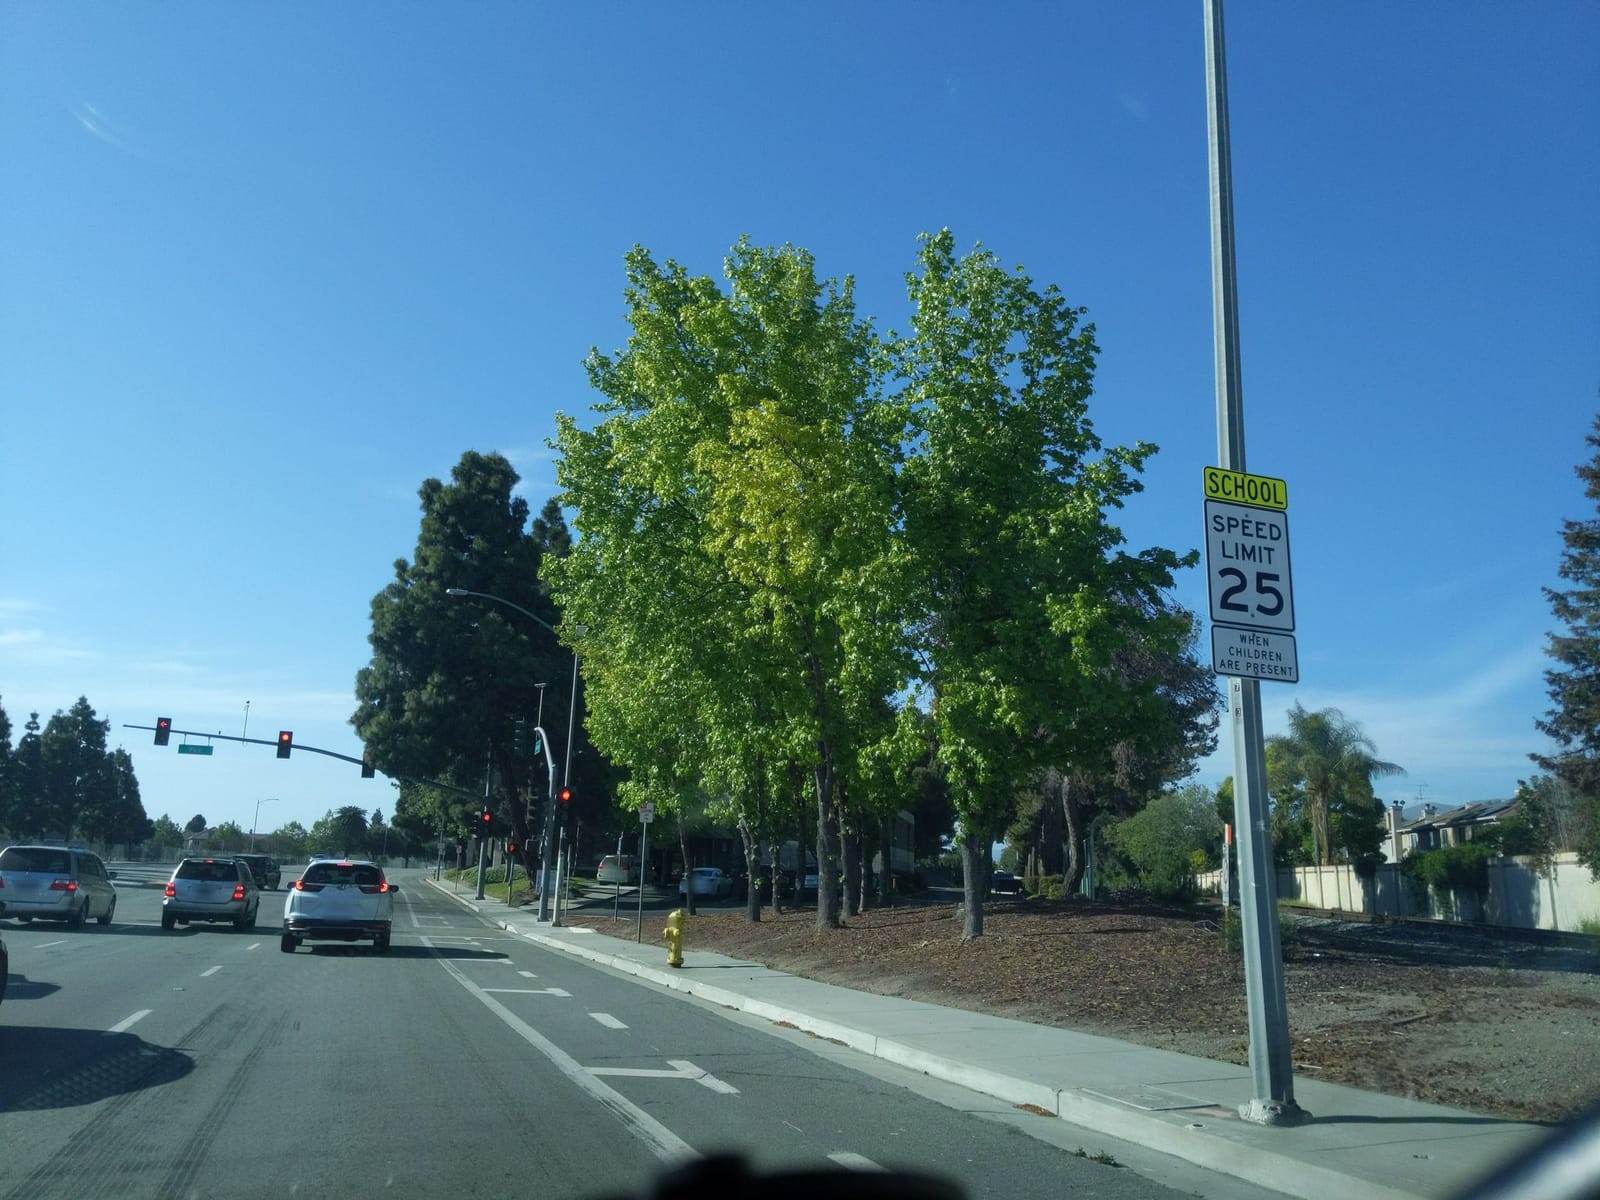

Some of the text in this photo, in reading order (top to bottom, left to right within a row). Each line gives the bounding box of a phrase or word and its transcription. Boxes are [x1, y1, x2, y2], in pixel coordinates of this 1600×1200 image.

[1209, 472, 1283, 505] SCHOOL
[1213, 515, 1282, 541] SPEED
[1222, 540, 1275, 565] LIMIT
[1218, 567, 1284, 616] 25
[1240, 634, 1269, 647] WHEN
[1229, 646, 1282, 662] CHILDREN
[1220, 659, 1293, 677] ARE PRESENT
